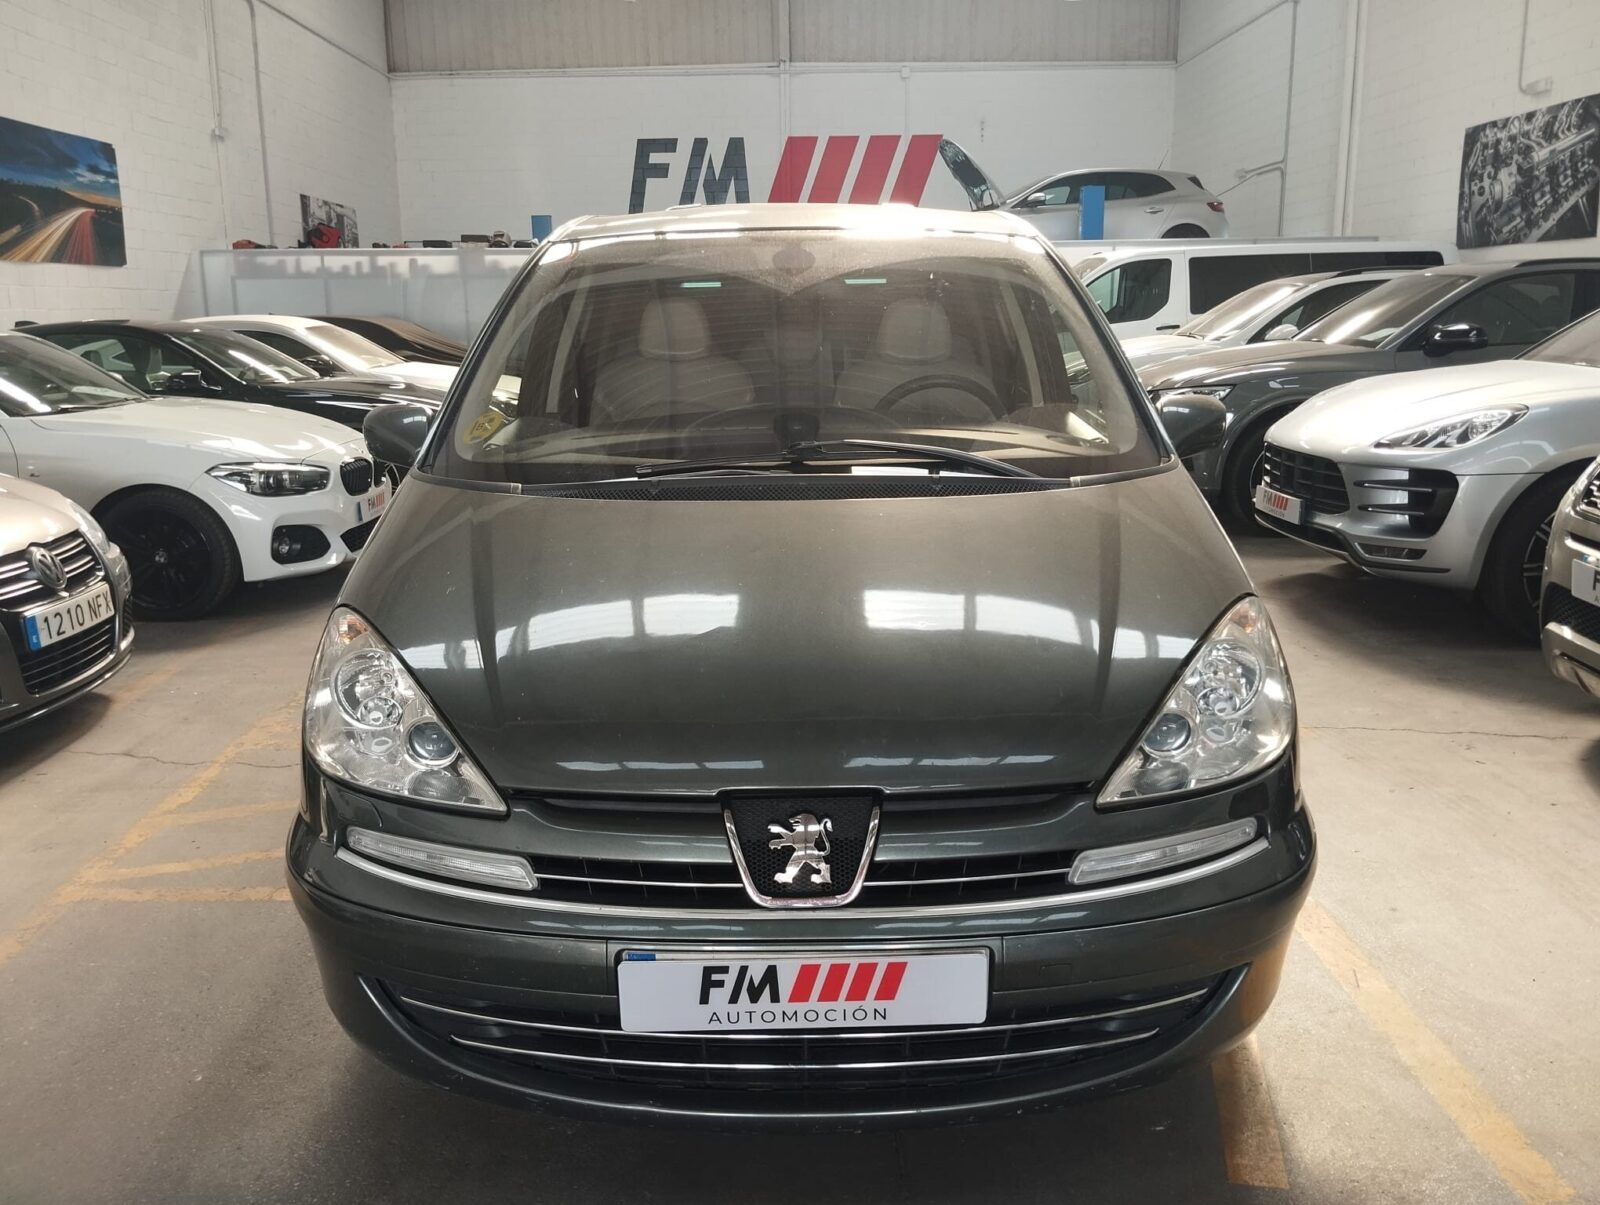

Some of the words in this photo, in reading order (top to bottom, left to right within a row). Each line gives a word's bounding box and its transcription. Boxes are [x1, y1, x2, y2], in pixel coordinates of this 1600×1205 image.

[628, 137, 750, 214] FM
[44, 604, 85, 640] 1210
[88, 591, 112, 622] NFX
[699, 964, 781, 1005] FM
[708, 1005, 888, 1025] AUTOMOCIÓN
